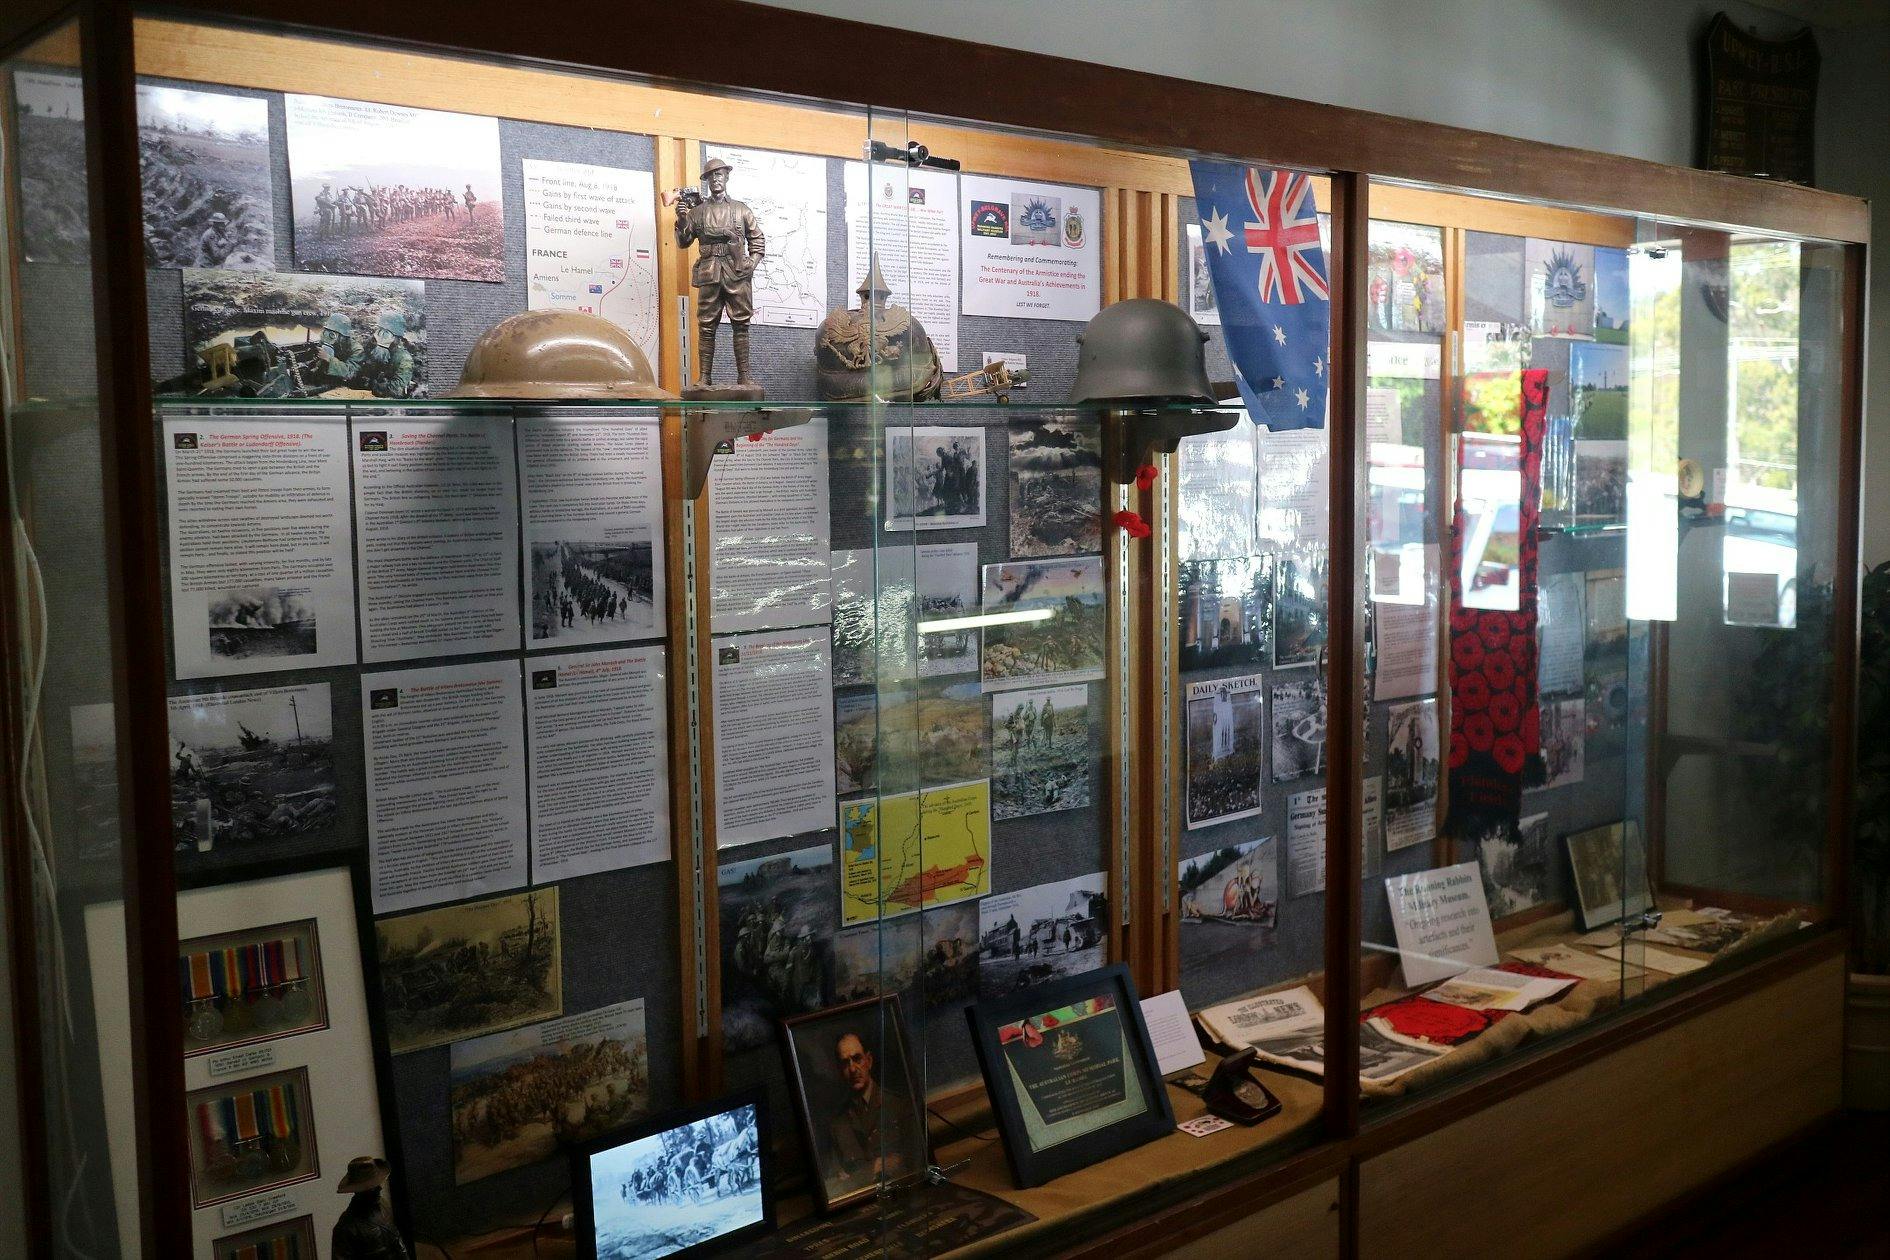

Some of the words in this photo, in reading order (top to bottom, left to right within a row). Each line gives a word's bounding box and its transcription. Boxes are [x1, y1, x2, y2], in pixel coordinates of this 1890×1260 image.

[542, 177, 560, 186] Front
[543, 190, 562, 198] Gains
[564, 191, 571, 200] by
[573, 192, 587, 200] first
[543, 201, 562, 210] Gains
[564, 203, 572, 212] by
[573, 204, 598, 213] second
[543, 213, 563, 223] Failed
[565, 214, 581, 223] third
[544, 226, 572, 236] German
[573, 228, 599, 237] defence
[601, 230, 613, 238] line
[532, 249, 568, 259] FRANCE
[987, 253, 1023, 263] Remembering
[1024, 255, 1034, 263] and
[1035, 256, 1078, 267] Commemorating:
[571, 266, 593, 275] Hamel
[981, 265, 990, 273] The
[991, 266, 1018, 276] Centenary
[1019, 268, 1024, 276] of
[1035, 269, 1059, 277] Armistice
[1060, 271, 1075, 280] ending
[1076, 271, 1086, 279] the
[533, 273, 560, 282] Amiens
[978, 276, 993, 284] Great
[994, 277, 1005, 285] War
[1018, 279, 1044, 287] Australia's
[1045, 281, 1080, 290] Achievements
[550, 292, 577, 302] Somme
[1026, 290, 1040, 298] 1918.
[1193, 684, 1218, 695] DAILY
[1222, 678, 1257, 690] SKETCH.
[1290, 811, 1316, 821] Germany
[1446, 874, 1472, 886] Rabbits
[1439, 892, 1470, 904] Museum.
[1440, 908, 1467, 921] research
[1448, 927, 1460, 937] and
[1460, 924, 1475, 933] their
[1273, 1002, 1303, 1014] NEWS
[848, 1237, 870, 1249] ROAD
